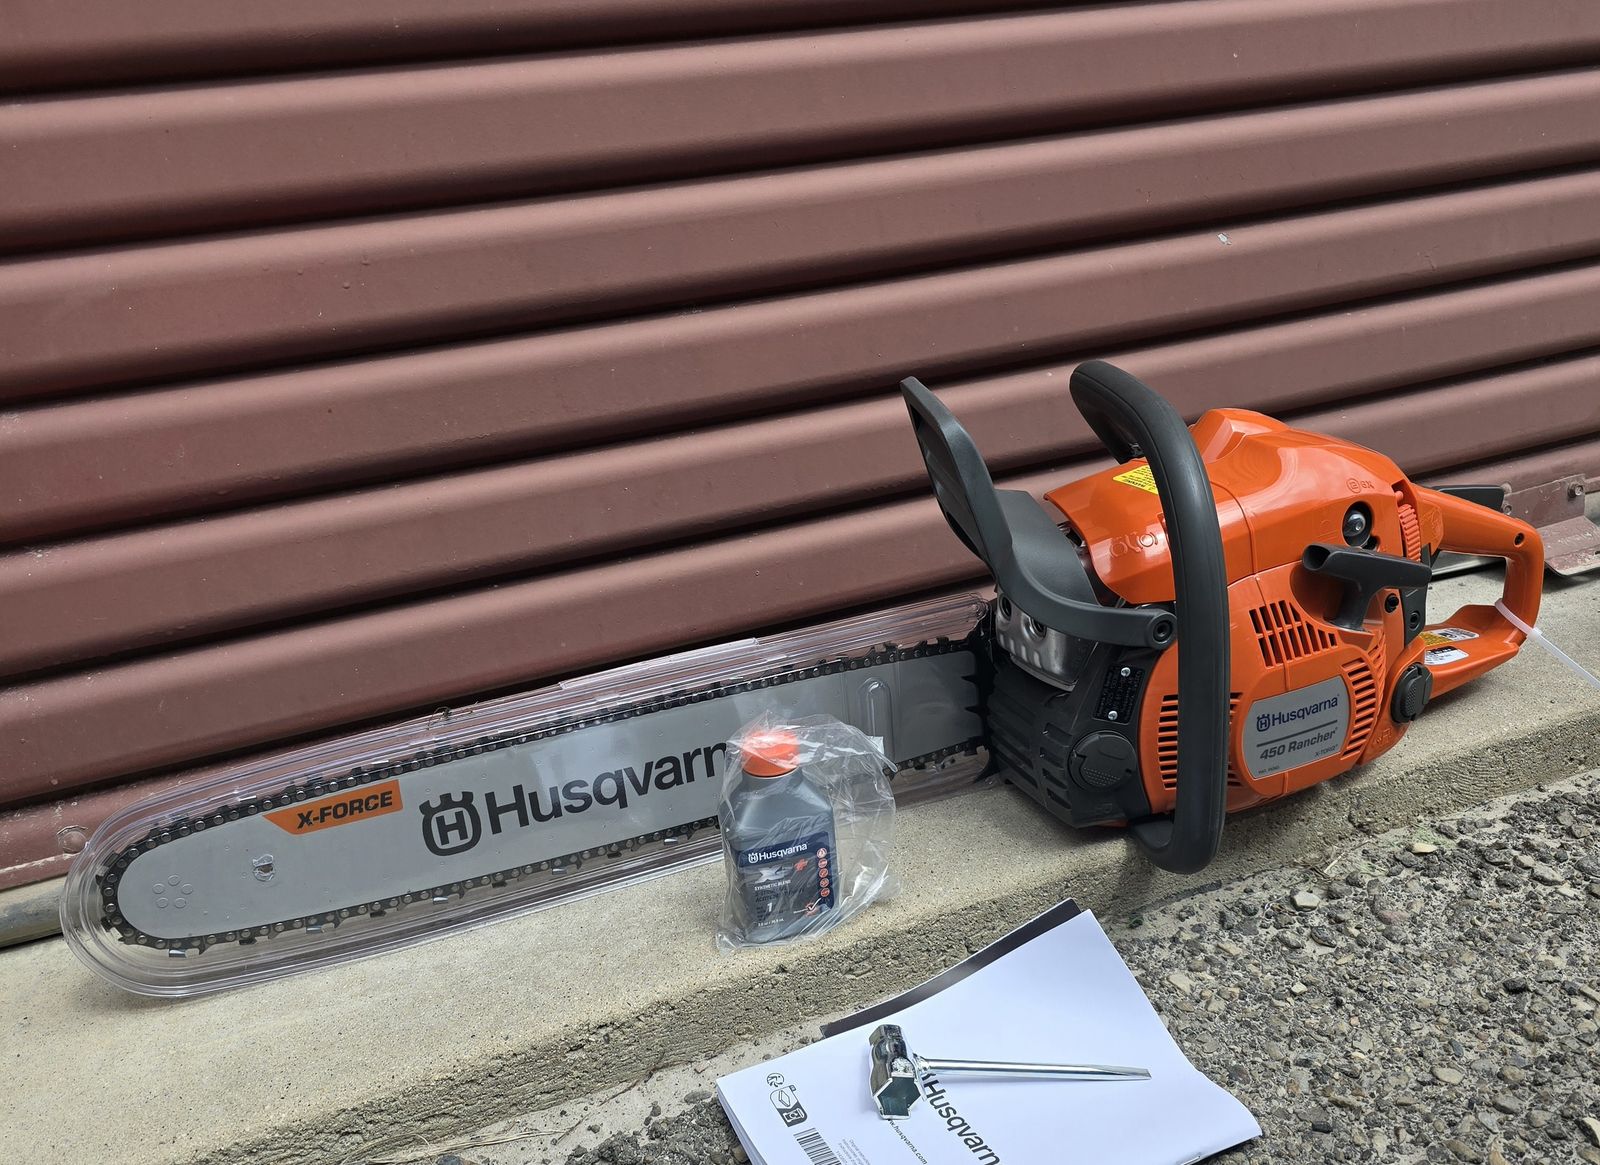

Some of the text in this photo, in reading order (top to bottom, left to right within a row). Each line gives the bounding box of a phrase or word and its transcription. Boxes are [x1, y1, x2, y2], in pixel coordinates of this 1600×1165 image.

[1271, 696, 1339, 726] Husqvarna
[1260, 730, 1336, 760] 450 Rancher
[484, 742, 727, 835] Husqvarn
[297, 790, 393, 830] X-FORCE
[758, 843, 808, 861] Husqvarna
[923, 1080, 1000, 1165] Husqvarn
